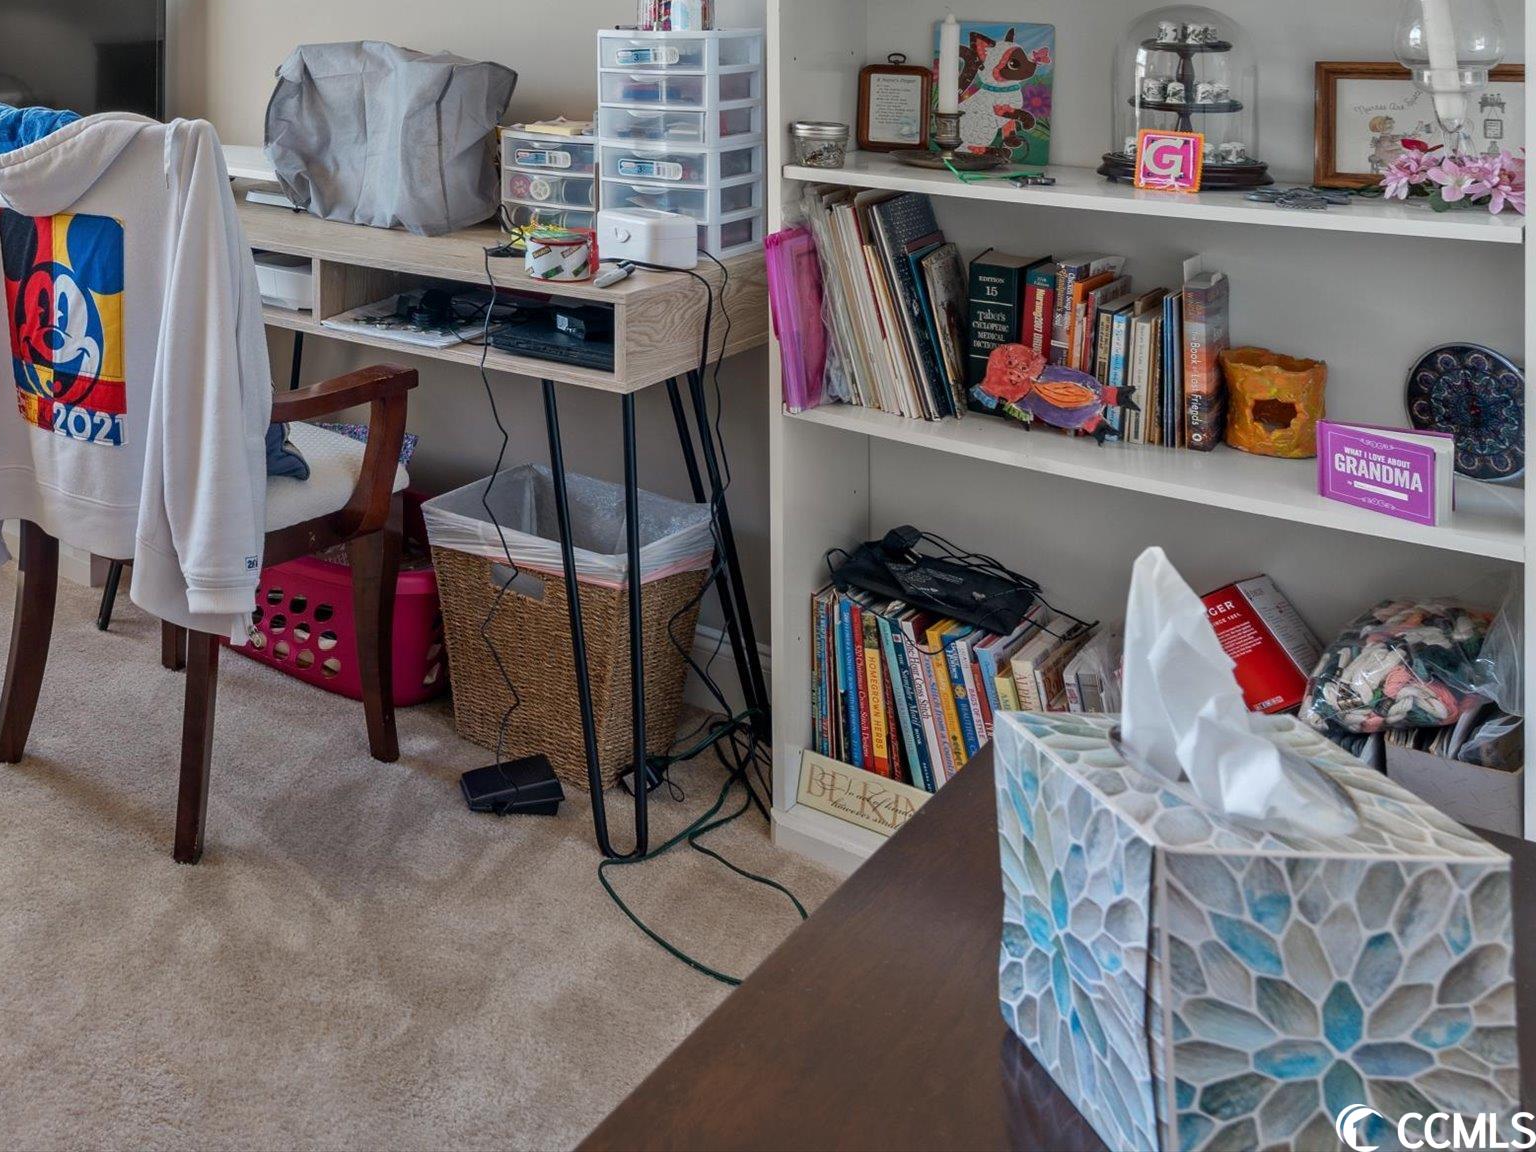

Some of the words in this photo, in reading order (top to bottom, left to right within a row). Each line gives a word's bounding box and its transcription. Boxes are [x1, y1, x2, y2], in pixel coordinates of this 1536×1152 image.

[1143, 138, 1184, 178] G
[978, 275, 1005, 284] EDITION
[1066, 272, 1075, 295] Chicken
[985, 286, 999, 297] 15
[977, 308, 1006, 322] Taber's
[977, 332, 1005, 342] MEDICAL
[1190, 341, 1200, 364] Book
[1190, 393, 1202, 425] Friends
[52, 400, 128, 446] 2021
[1344, 447, 1362, 458] WHAT
[1368, 453, 1385, 464] LOVE
[1387, 457, 1411, 469] ABOUT
[1334, 453, 1423, 493] GRANDMA
[1208, 600, 1235, 618] GER
[867, 655, 881, 716] HOMEGROWN
[913, 676, 927, 699] Cross
[967, 687, 978, 706] BAGS
[974, 718, 985, 740] STYLE
[873, 719, 885, 750] HERBS
[830, 798, 870, 821] however
